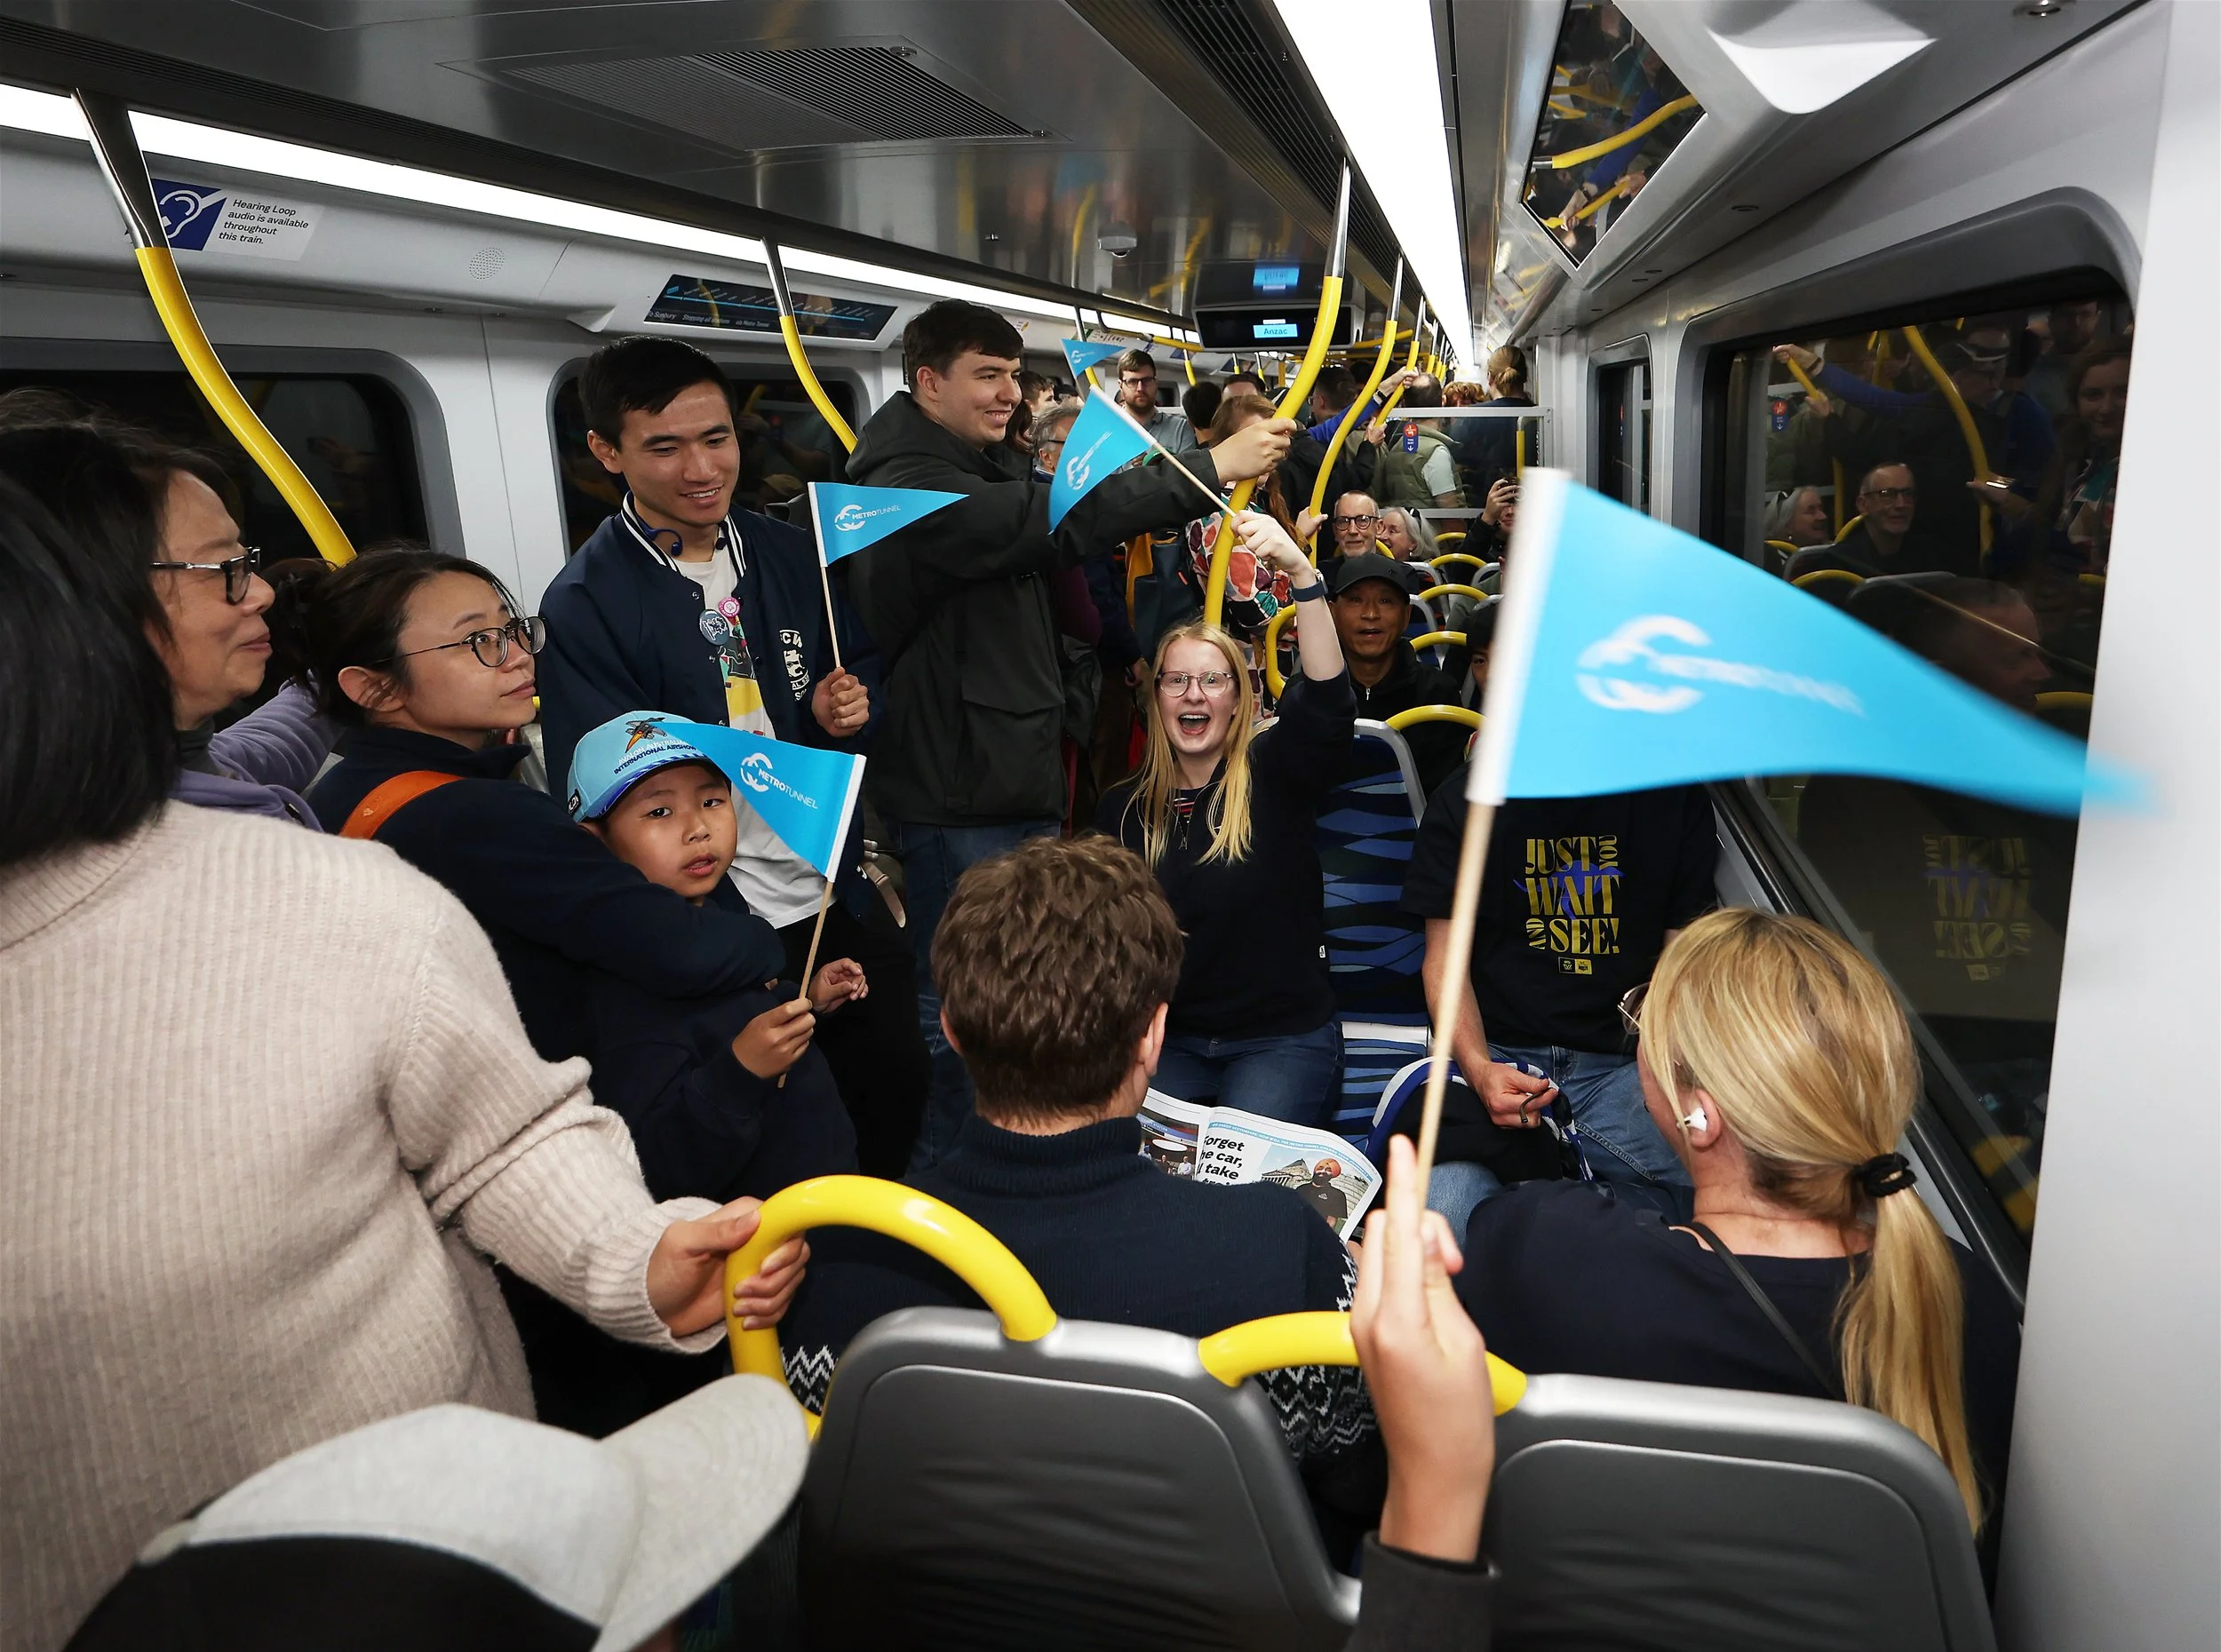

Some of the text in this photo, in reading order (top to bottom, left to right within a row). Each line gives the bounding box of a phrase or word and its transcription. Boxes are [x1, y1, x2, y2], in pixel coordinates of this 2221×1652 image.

[233, 199, 296, 217] Hearing Loop
[224, 221, 277, 234] throughout
[228, 211, 255, 221] audio
[267, 218, 309, 228] available
[219, 232, 264, 244] this train.
[852, 504, 901, 520] METROTUNNEL
[614, 746, 666, 774] INTERNATIONAL
[618, 746, 645, 766] AVALON
[758, 768, 817, 809] METROTUNNEL
[1525, 835, 1619, 874] JUST YOU
[1525, 875, 1620, 916] WAIT
[1526, 918, 1620, 955] AND SEE!
[1216, 1153, 1242, 1169] car,
[1205, 1164, 1239, 1179] take
